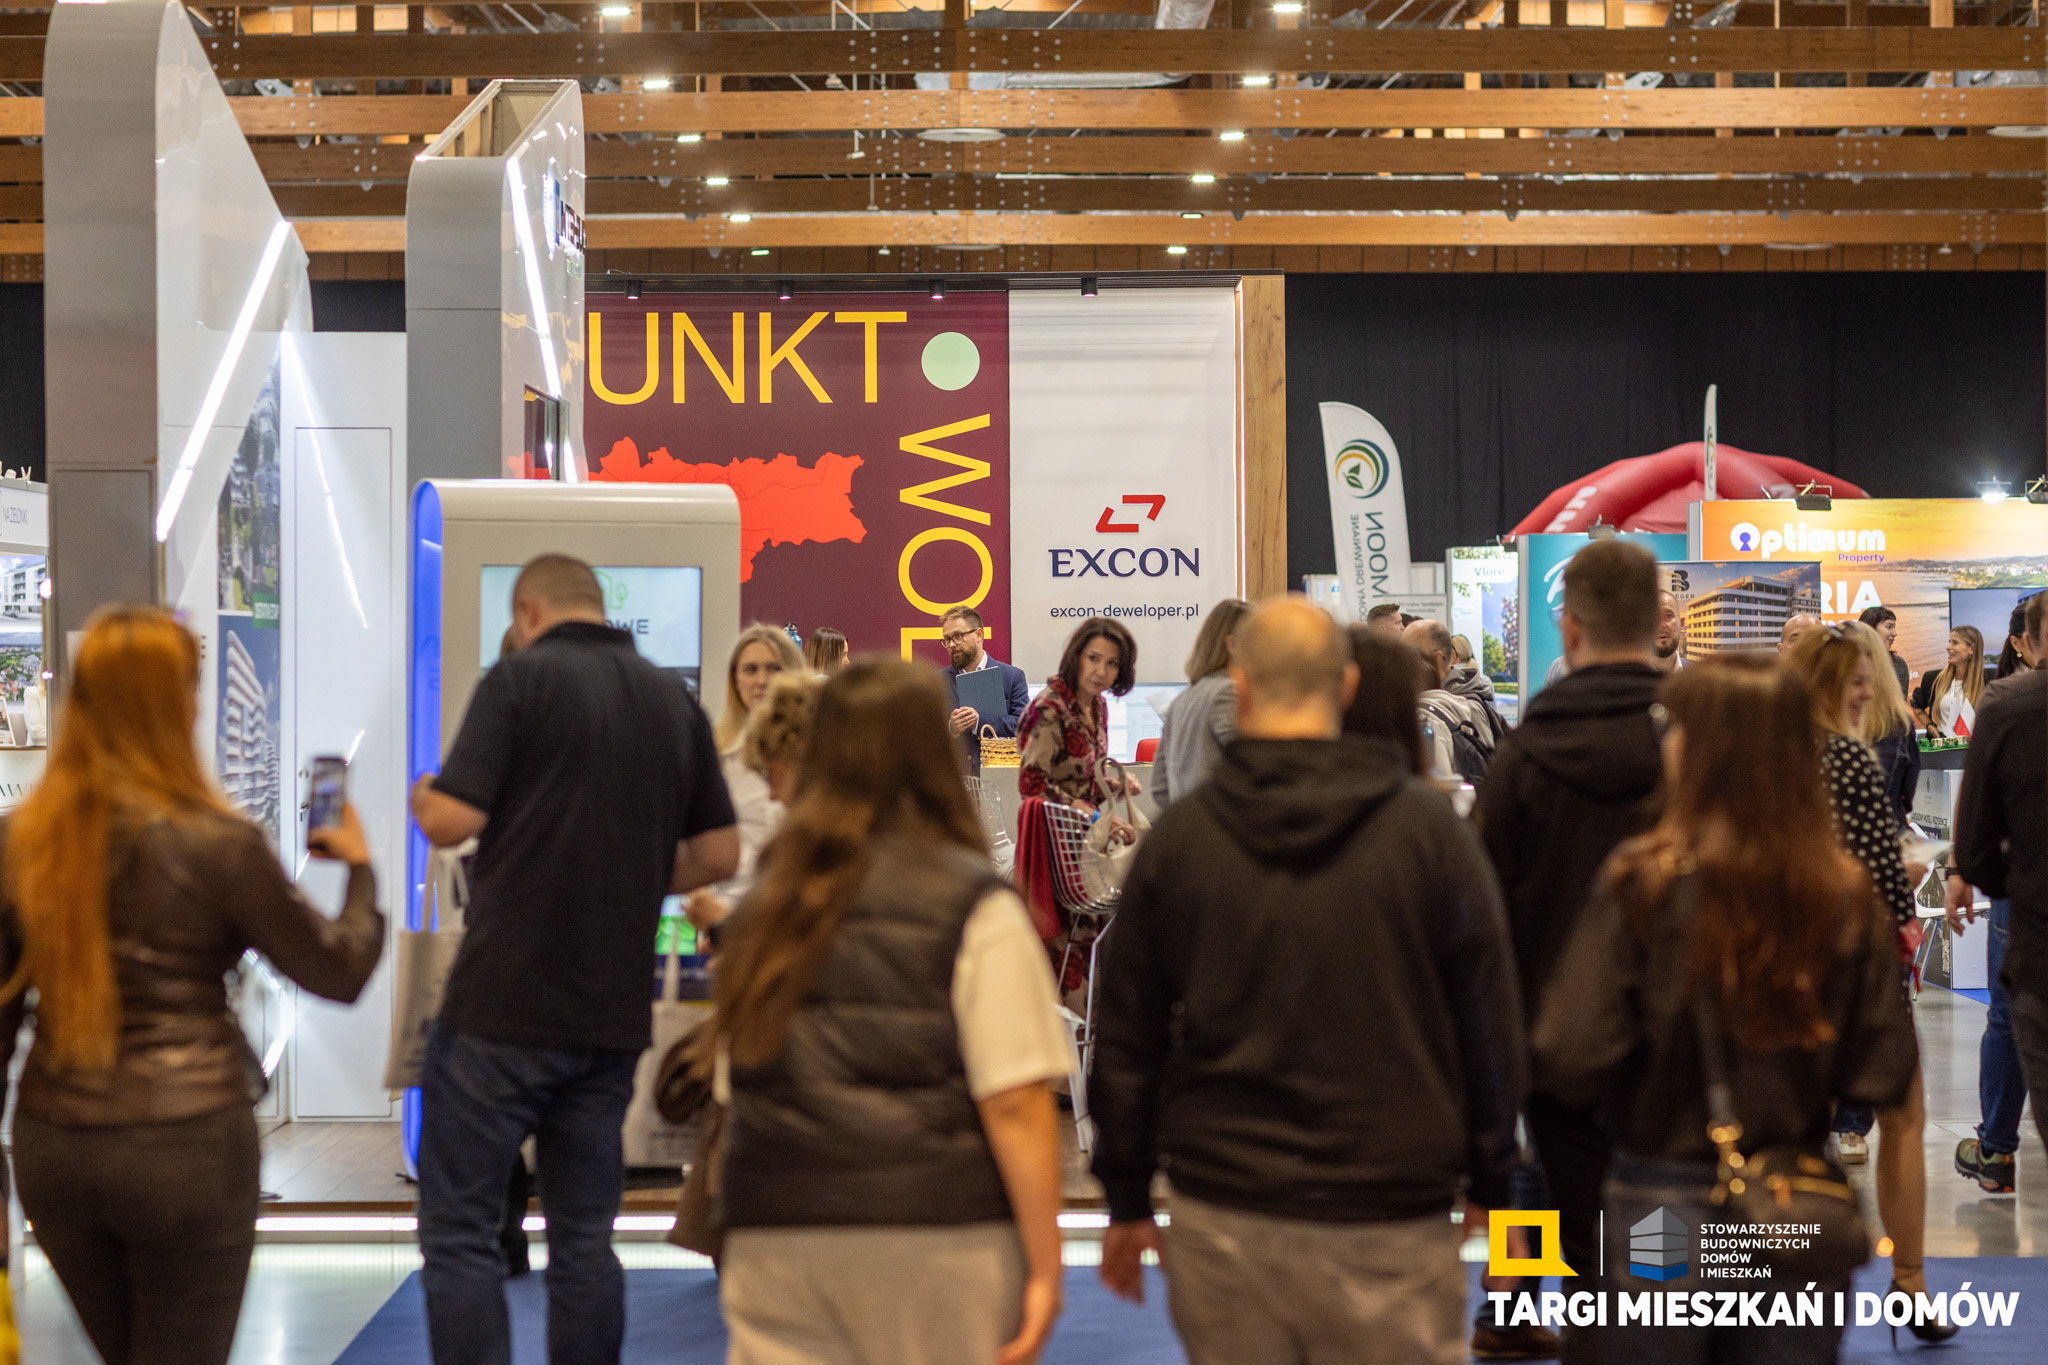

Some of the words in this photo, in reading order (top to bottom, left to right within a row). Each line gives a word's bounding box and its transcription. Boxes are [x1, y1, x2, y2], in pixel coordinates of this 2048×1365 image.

[1730, 522, 1885, 559] Optimum
[1048, 547, 1200, 578] EXCON
[1838, 553, 1885, 563] Property
[1050, 604, 1199, 620] excon-deweloper.pl
